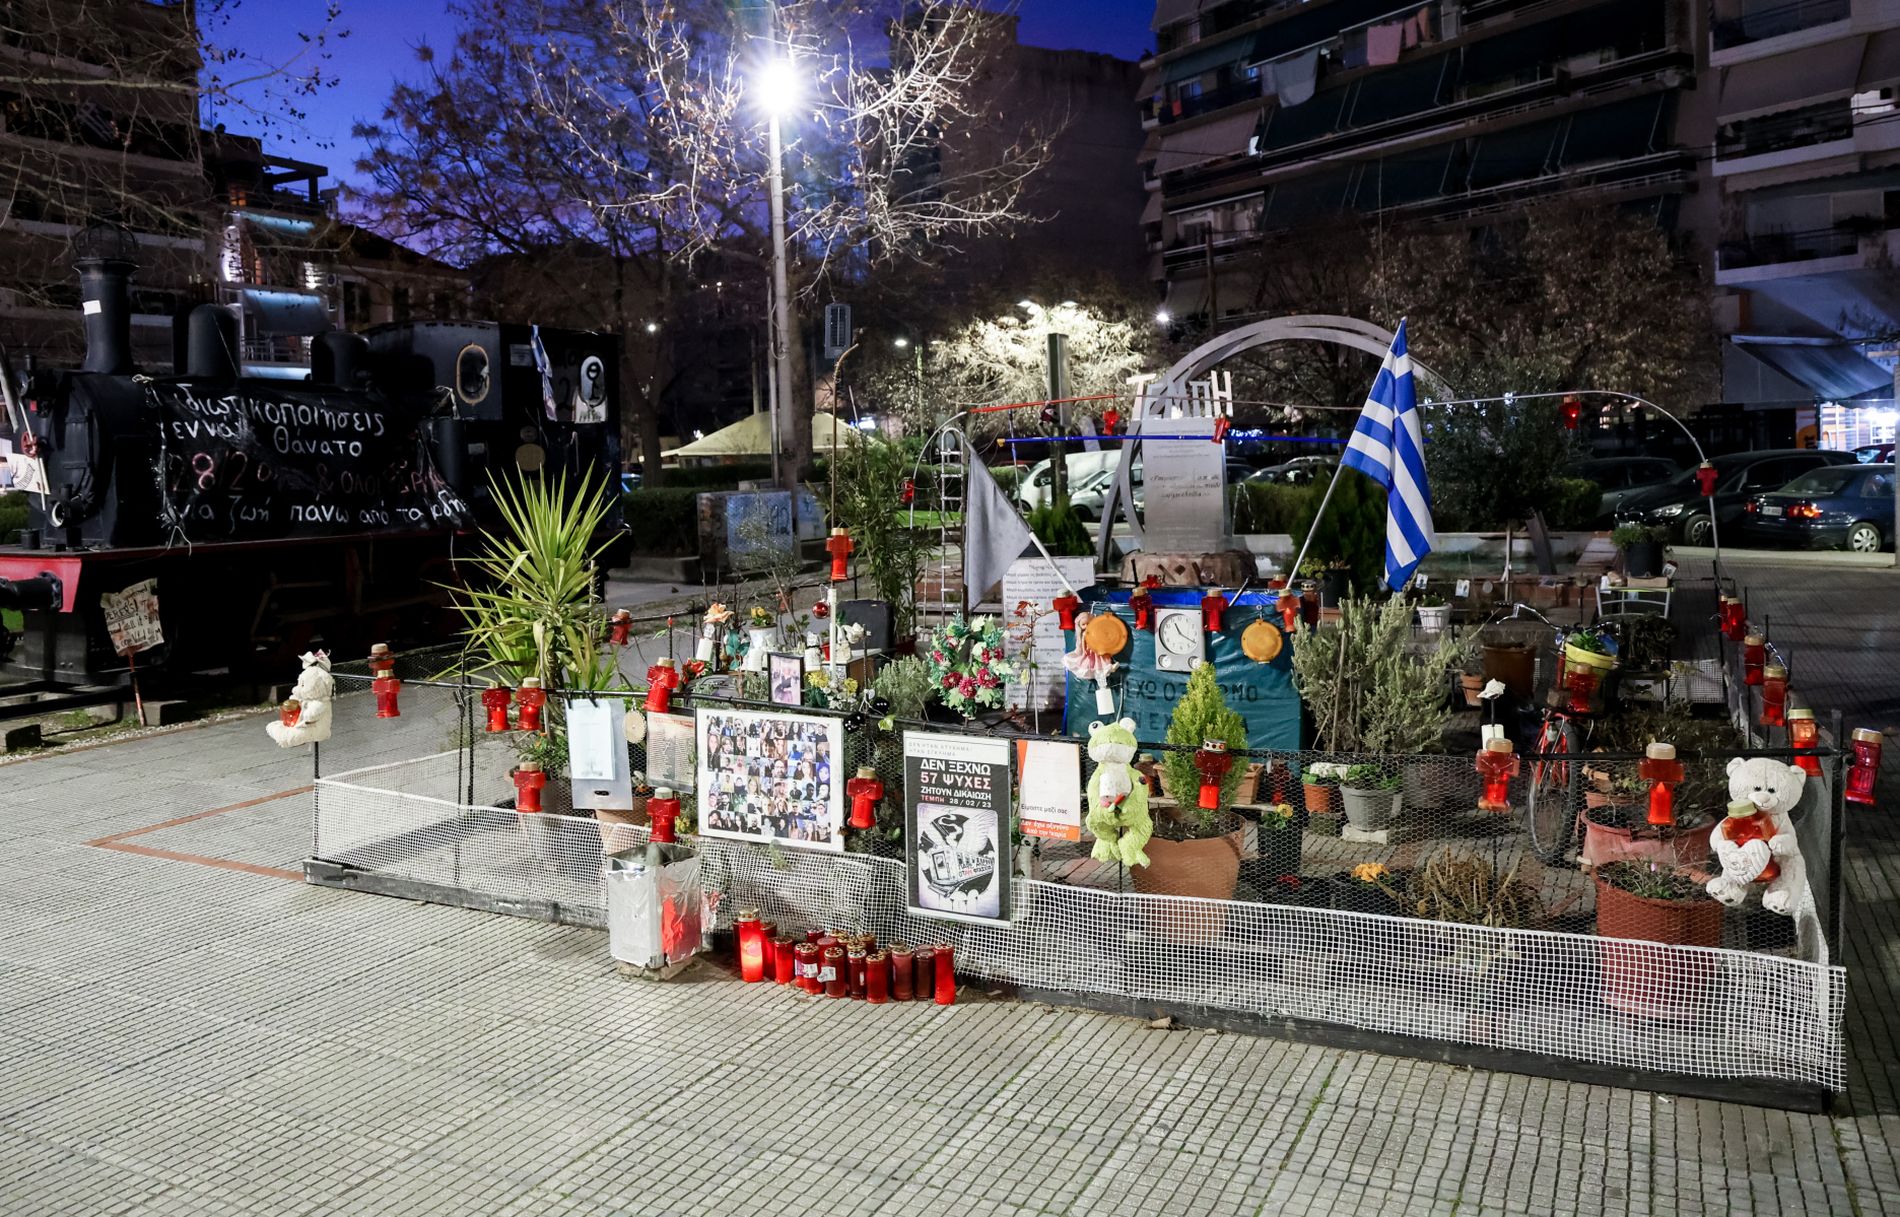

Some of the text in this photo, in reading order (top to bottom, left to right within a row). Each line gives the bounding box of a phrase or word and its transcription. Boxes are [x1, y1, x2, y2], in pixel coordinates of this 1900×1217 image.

[1126, 370, 1234, 422] ΤΕΜΠΗ
[920, 758, 991, 776] ΔΕΝ ΞΕΧΝΩ
[920, 771, 991, 790] 57 ΨΥΧΕΣ
[920, 786, 992, 801] ΖΗΤΟΥΝ ΔΙΚΑΙΩΣΗ
[920, 795, 945, 803] ΤΕΜΠΗ
